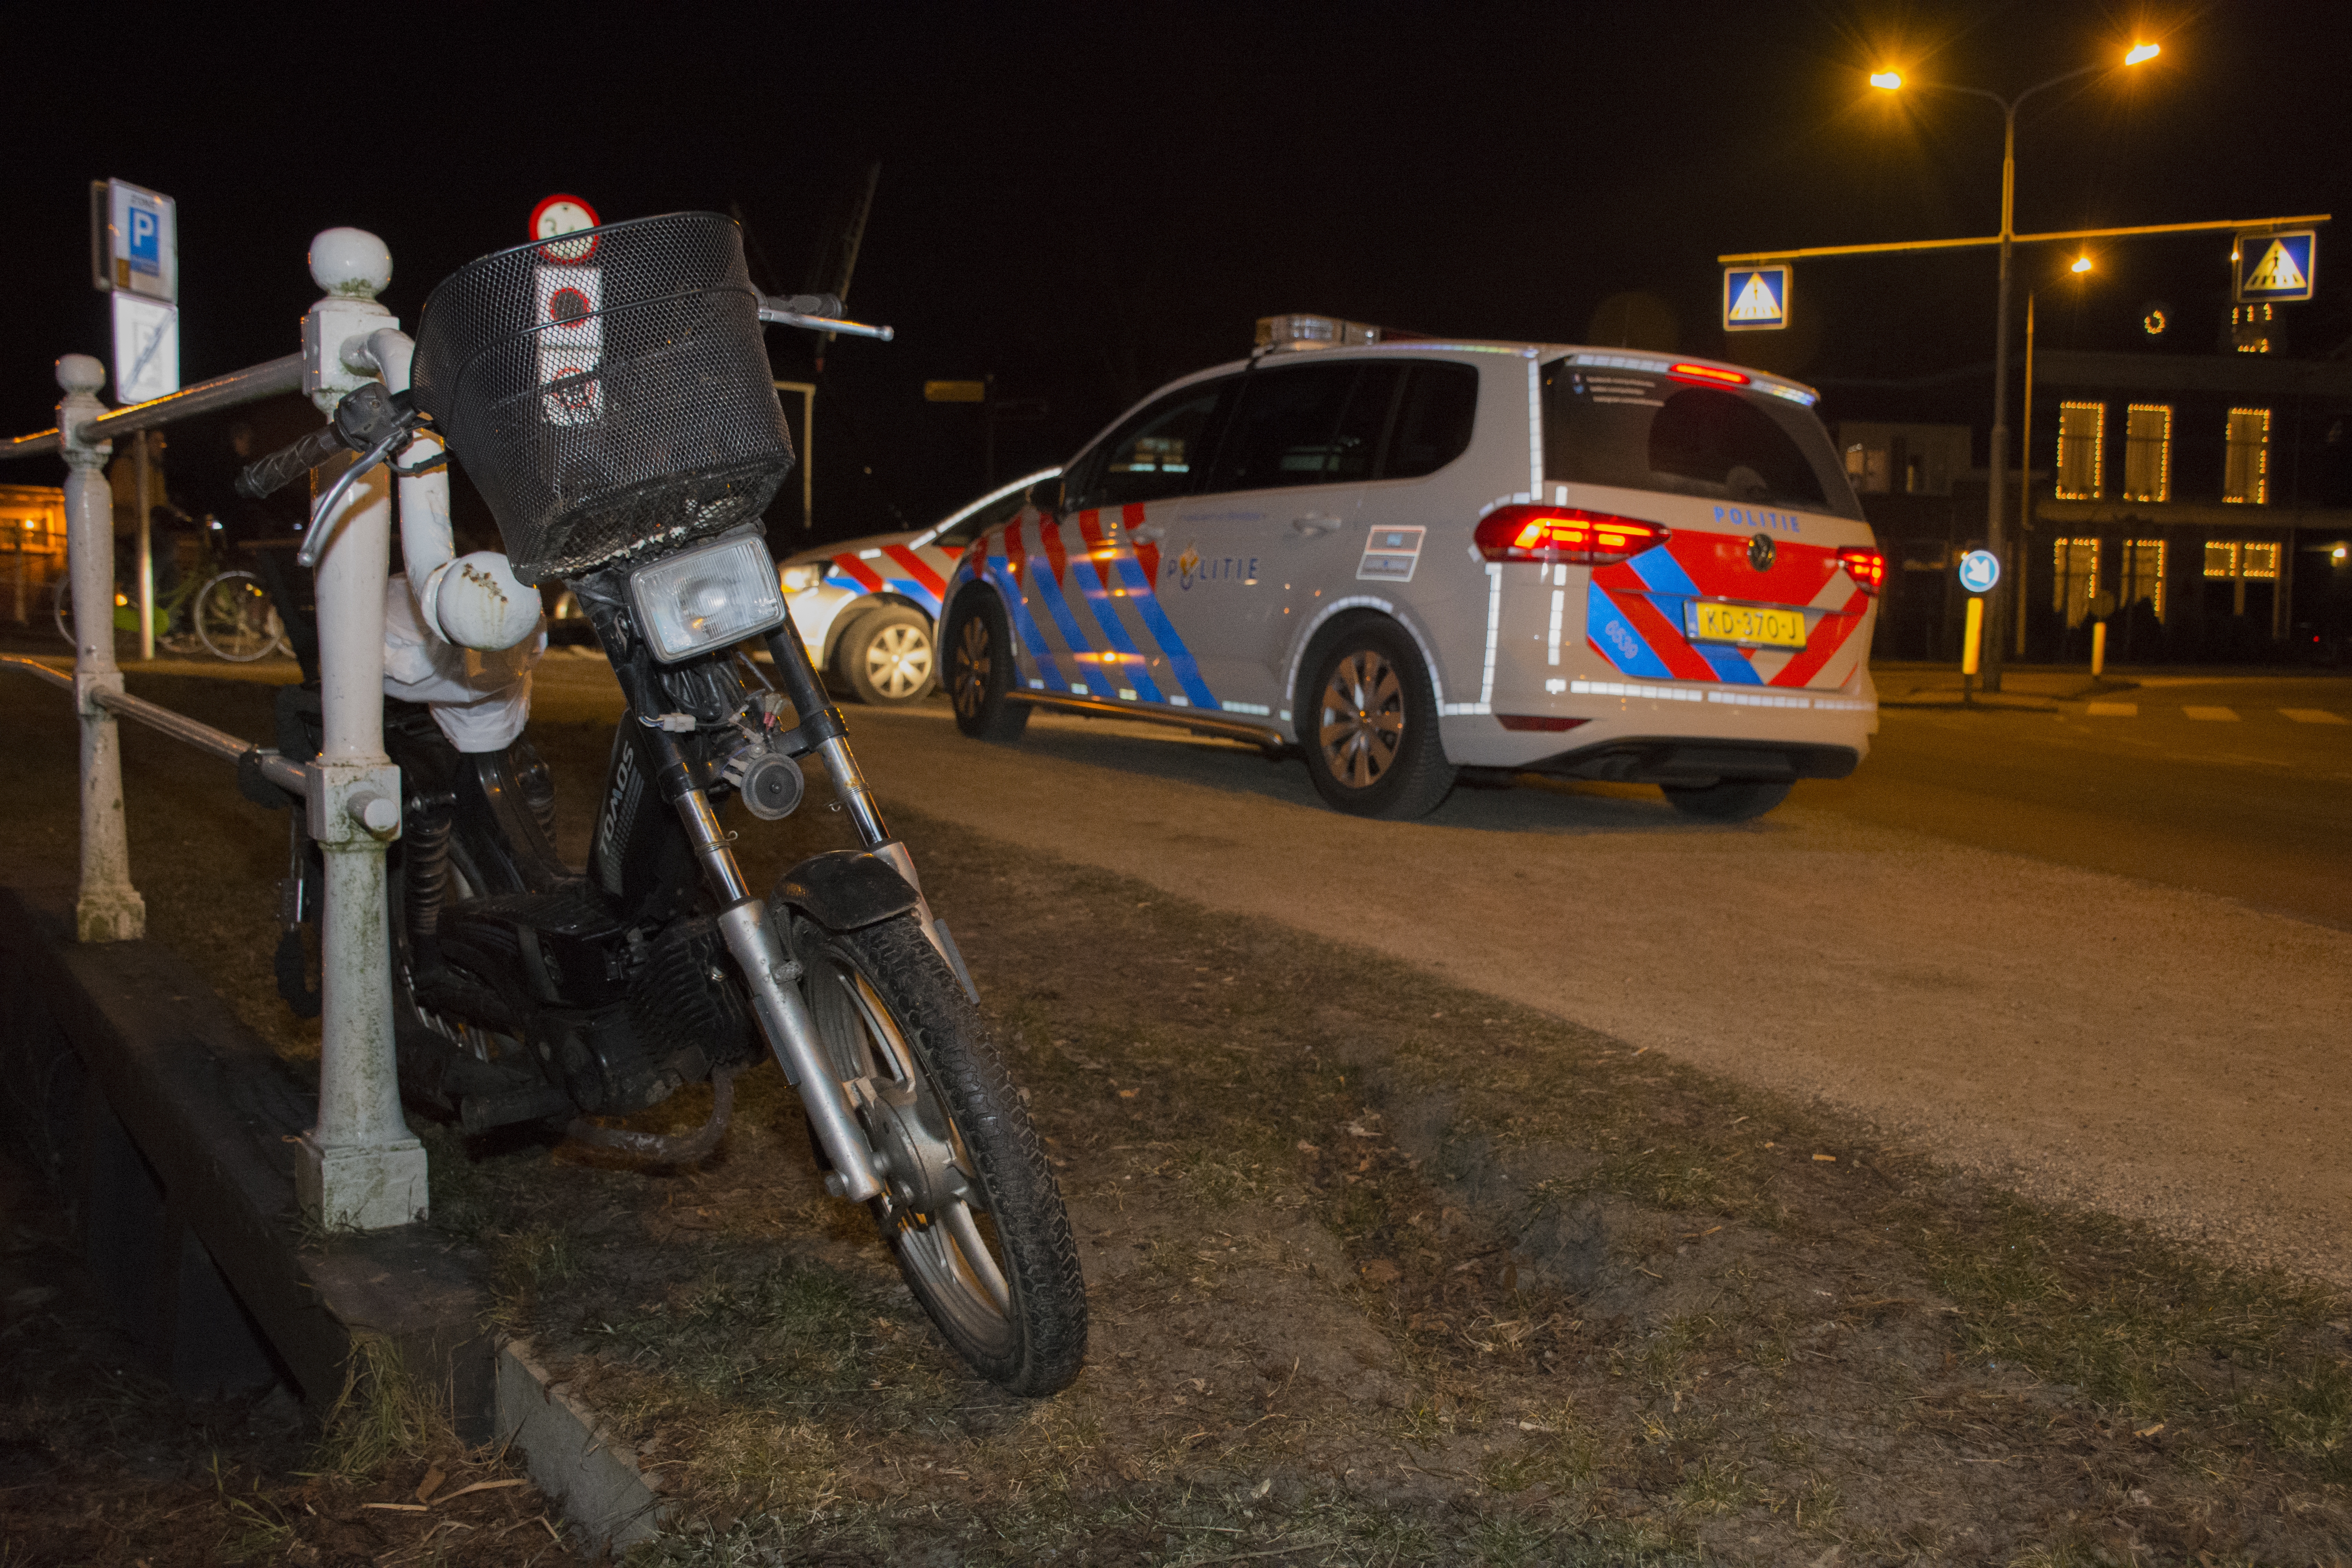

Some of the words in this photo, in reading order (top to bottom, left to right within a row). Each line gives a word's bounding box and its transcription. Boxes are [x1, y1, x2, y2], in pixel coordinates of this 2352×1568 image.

[134, 212, 154, 248] P
[1713, 505, 1800, 534] POLITIE
[1706, 608, 1796, 640] KD-370-J
[599, 740, 633, 855] TOMOS
